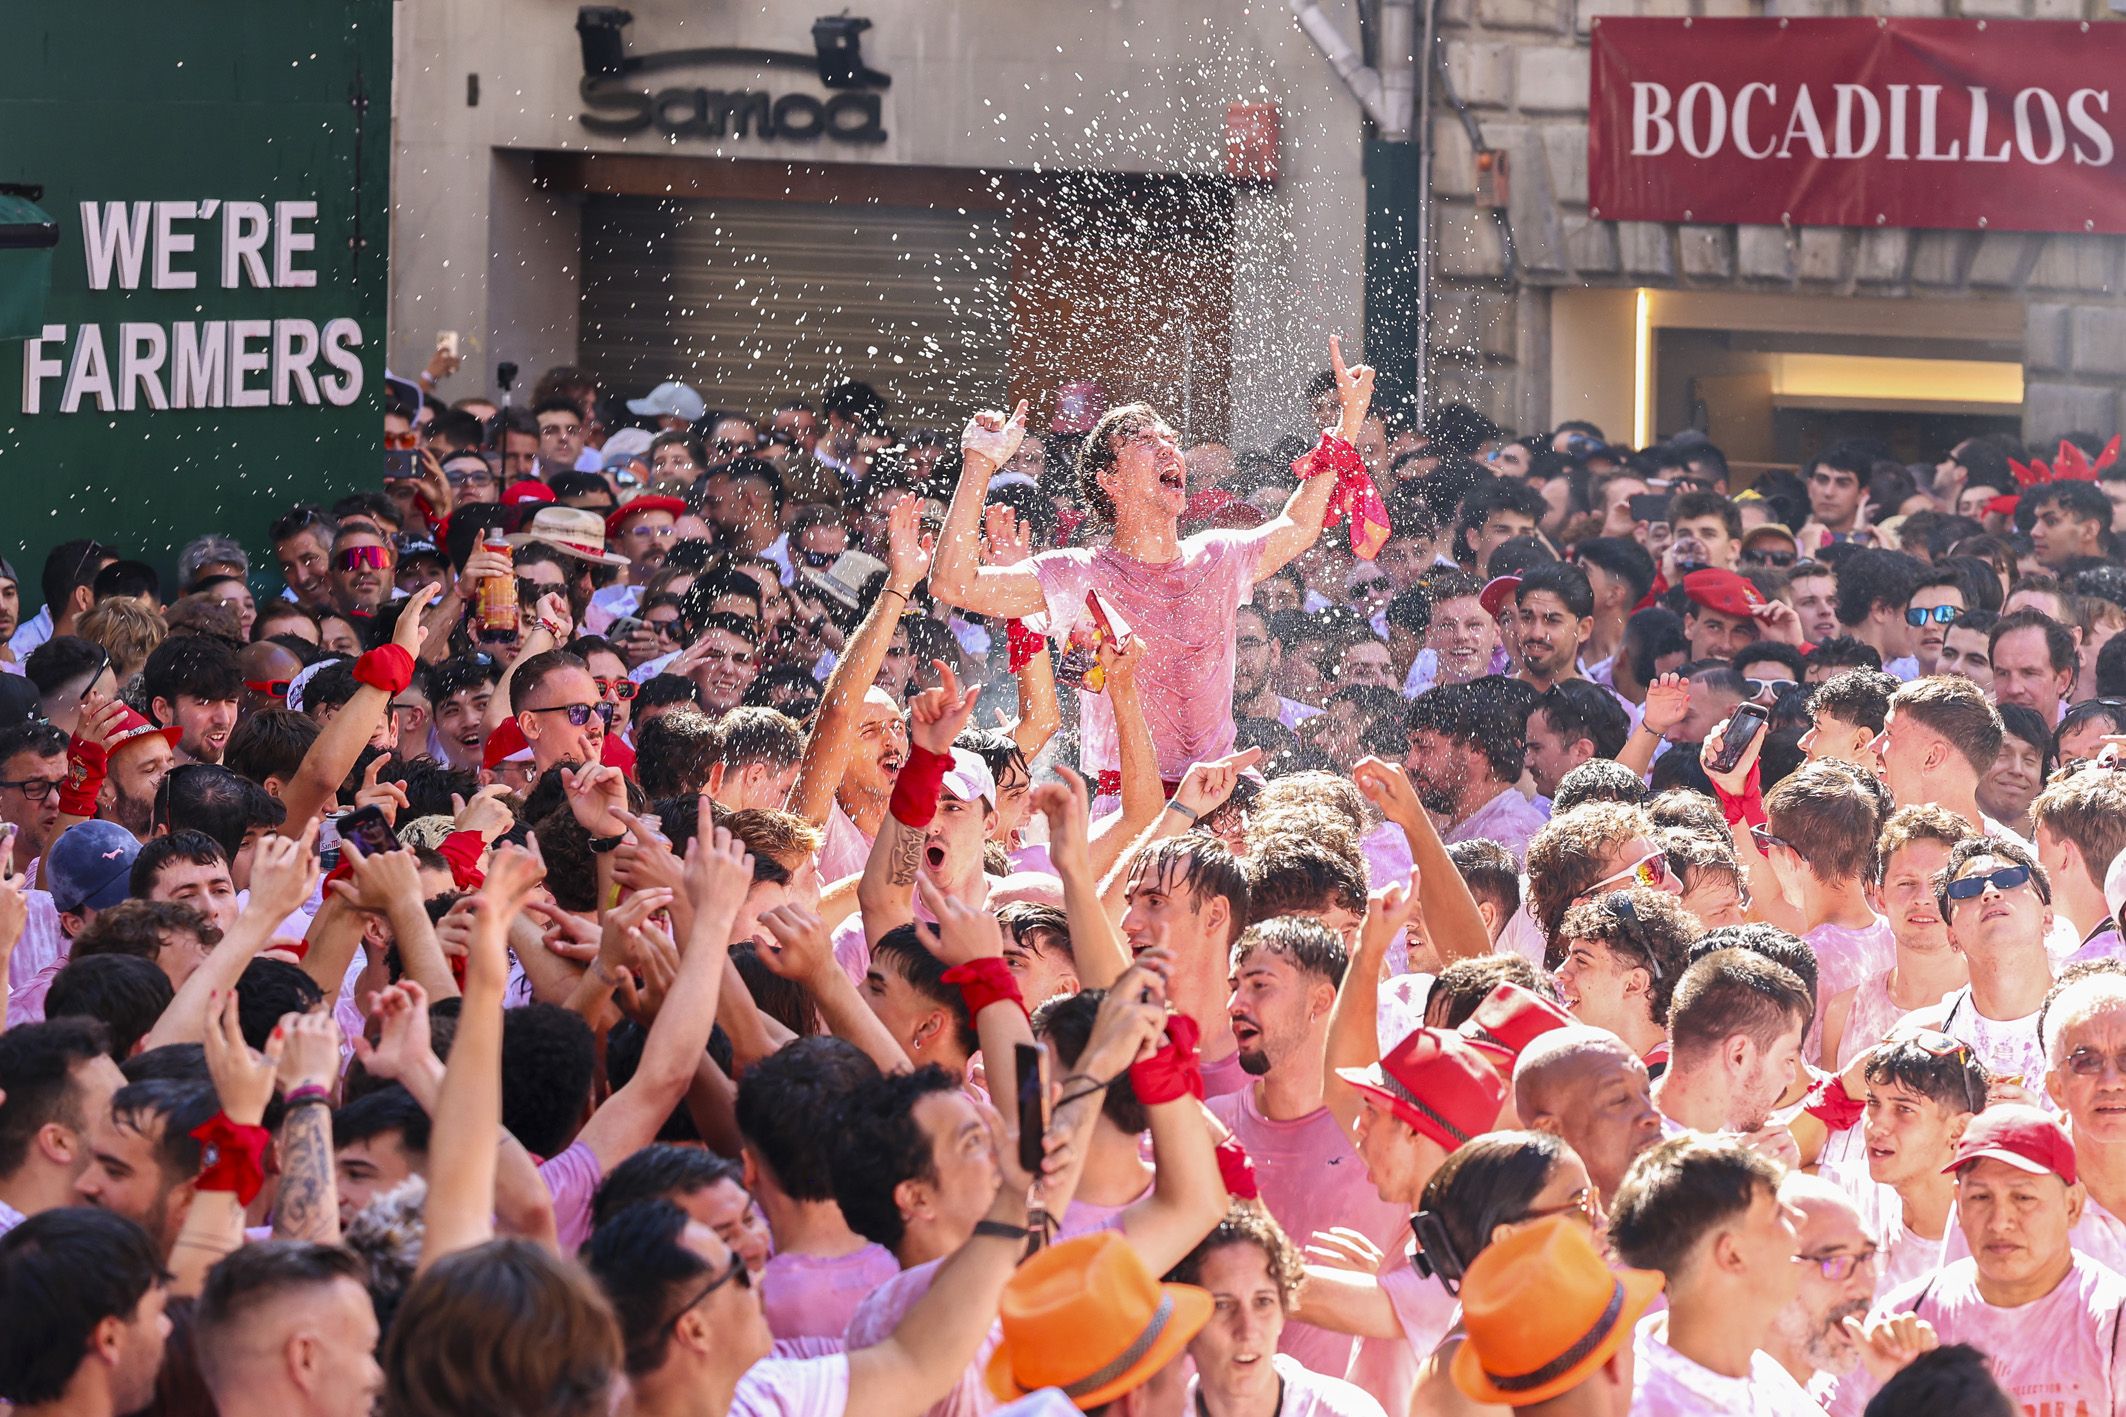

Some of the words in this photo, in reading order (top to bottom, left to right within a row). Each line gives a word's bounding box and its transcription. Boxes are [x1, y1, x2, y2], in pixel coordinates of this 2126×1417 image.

[579, 72, 888, 143] Samoa
[1631, 81, 2115, 167] BOCADILLOS
[80, 199, 318, 290] WE'RE
[22, 318, 364, 414] FARMERS
